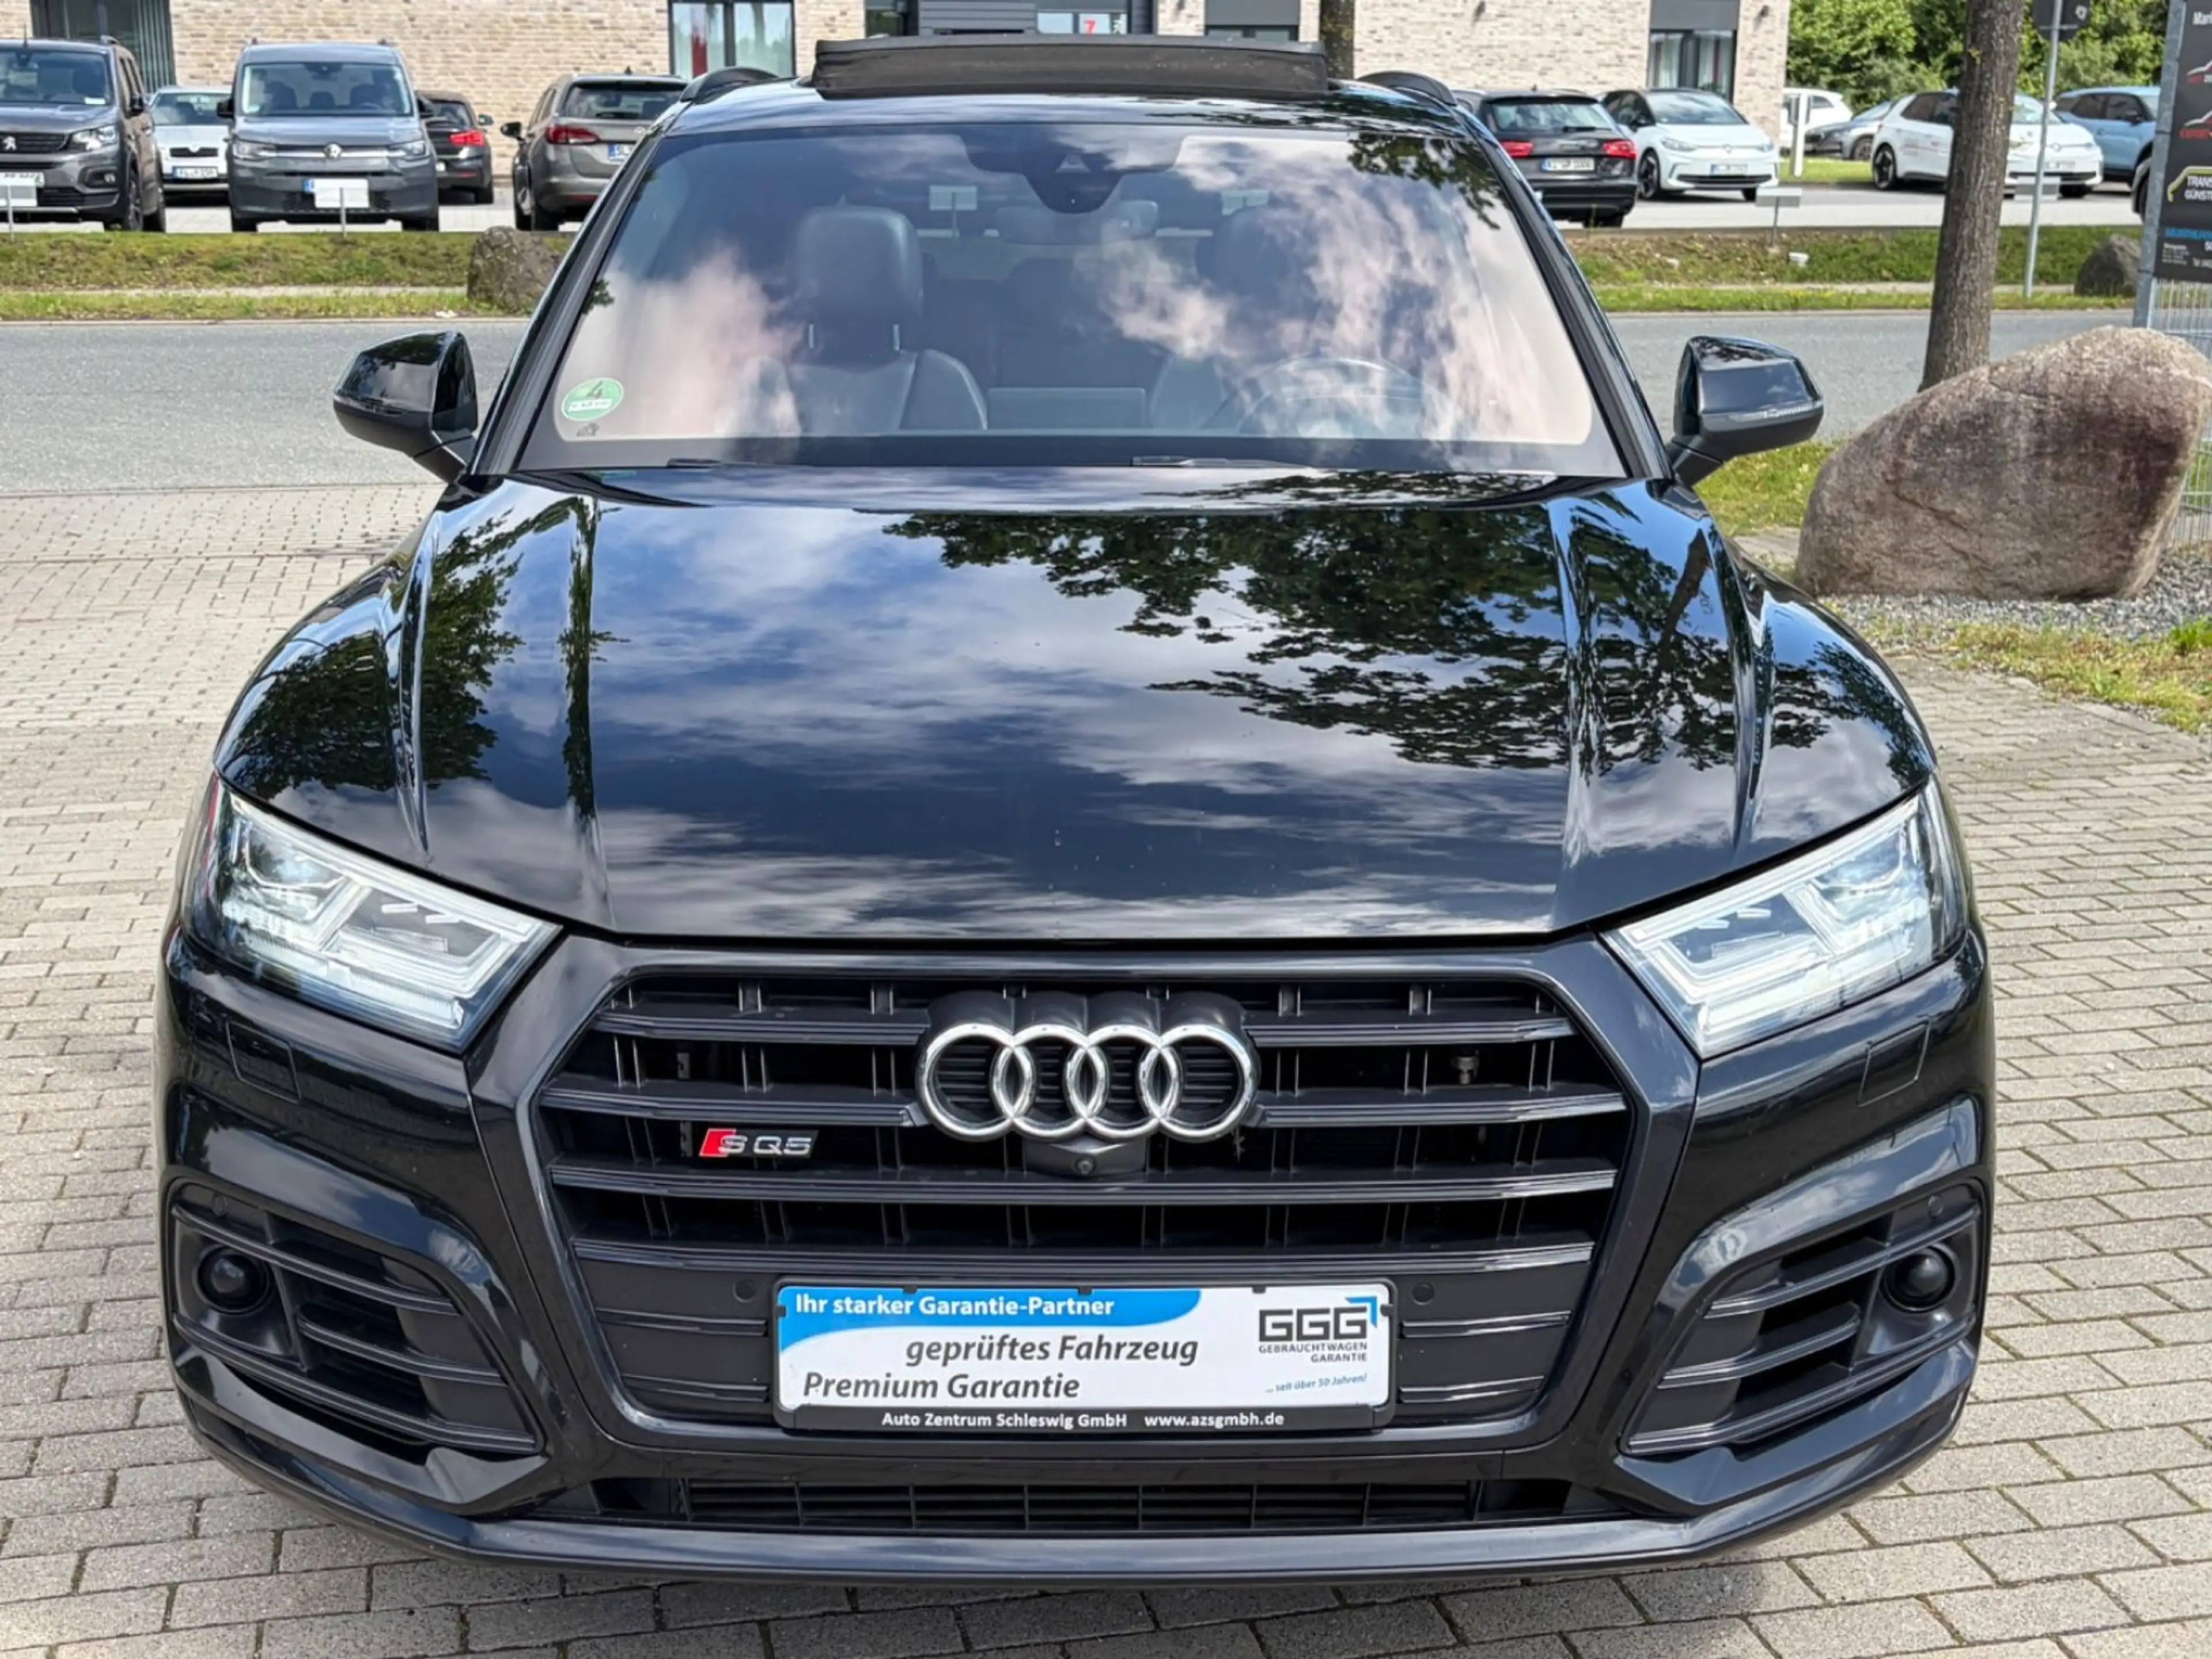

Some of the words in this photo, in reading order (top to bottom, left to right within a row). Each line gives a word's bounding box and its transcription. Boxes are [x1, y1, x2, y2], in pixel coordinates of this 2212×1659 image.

[796, 1293, 828, 1313] Ihr
[833, 1294, 914, 1315] starker
[919, 1296, 1115, 1316] Garantie-Partner
[1259, 1305, 1367, 1342] GGG
[906, 1334, 1050, 1367] geprüftes
[1058, 1334, 1199, 1366] Fahrzeug
[1259, 1342, 1368, 1354] GEBRAUCHTWAGEN
[1310, 1353, 1368, 1363] GARANTIE
[803, 1372, 939, 1399] Premium
[947, 1373, 1080, 1399] Garantie
[882, 1412, 921, 1426] Auto
[925, 1413, 991, 1427] Zentrum
[996, 1413, 1074, 1430] Schleswig
[1078, 1413, 1127, 1427] GmbH
[1144, 1411, 1284, 1429] www.azsgmbh.de
